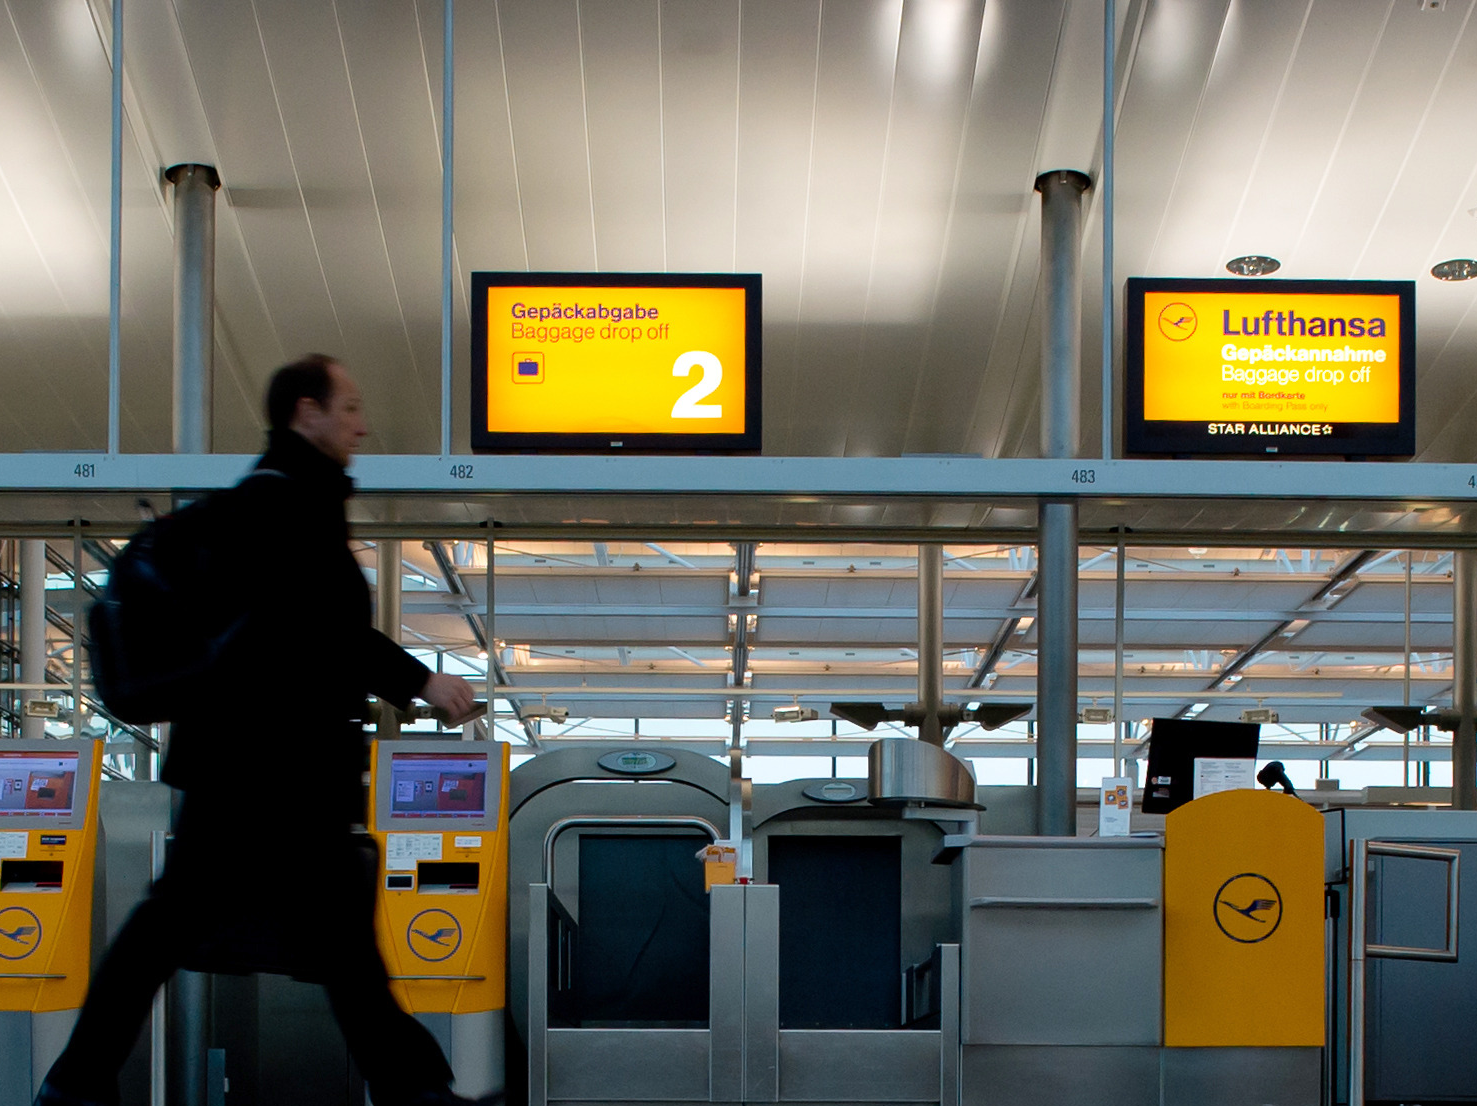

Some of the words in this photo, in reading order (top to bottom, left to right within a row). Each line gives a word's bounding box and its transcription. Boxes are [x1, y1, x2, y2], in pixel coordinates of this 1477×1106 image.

[511, 303, 658, 322] Gepäckabgabe
[512, 323, 595, 342] Baggage
[599, 323, 642, 342] drop
[647, 323, 670, 340] off
[1223, 310, 1386, 338] Lufthansa
[1221, 344, 1386, 364] Gepäckannahme
[671, 350, 723, 418] 2
[1221, 365, 1299, 385] Baggage
[1305, 366, 1344, 385] drop
[1349, 366, 1371, 382] off
[1241, 391, 1255, 399] mit
[1259, 391, 1305, 400] Bordkarte
[1208, 423, 1245, 434] STAR
[1249, 423, 1321, 435] ALLIANCE
[74, 464, 95, 478] 481
[450, 464, 473, 479] 482
[1071, 470, 1095, 484] 483
